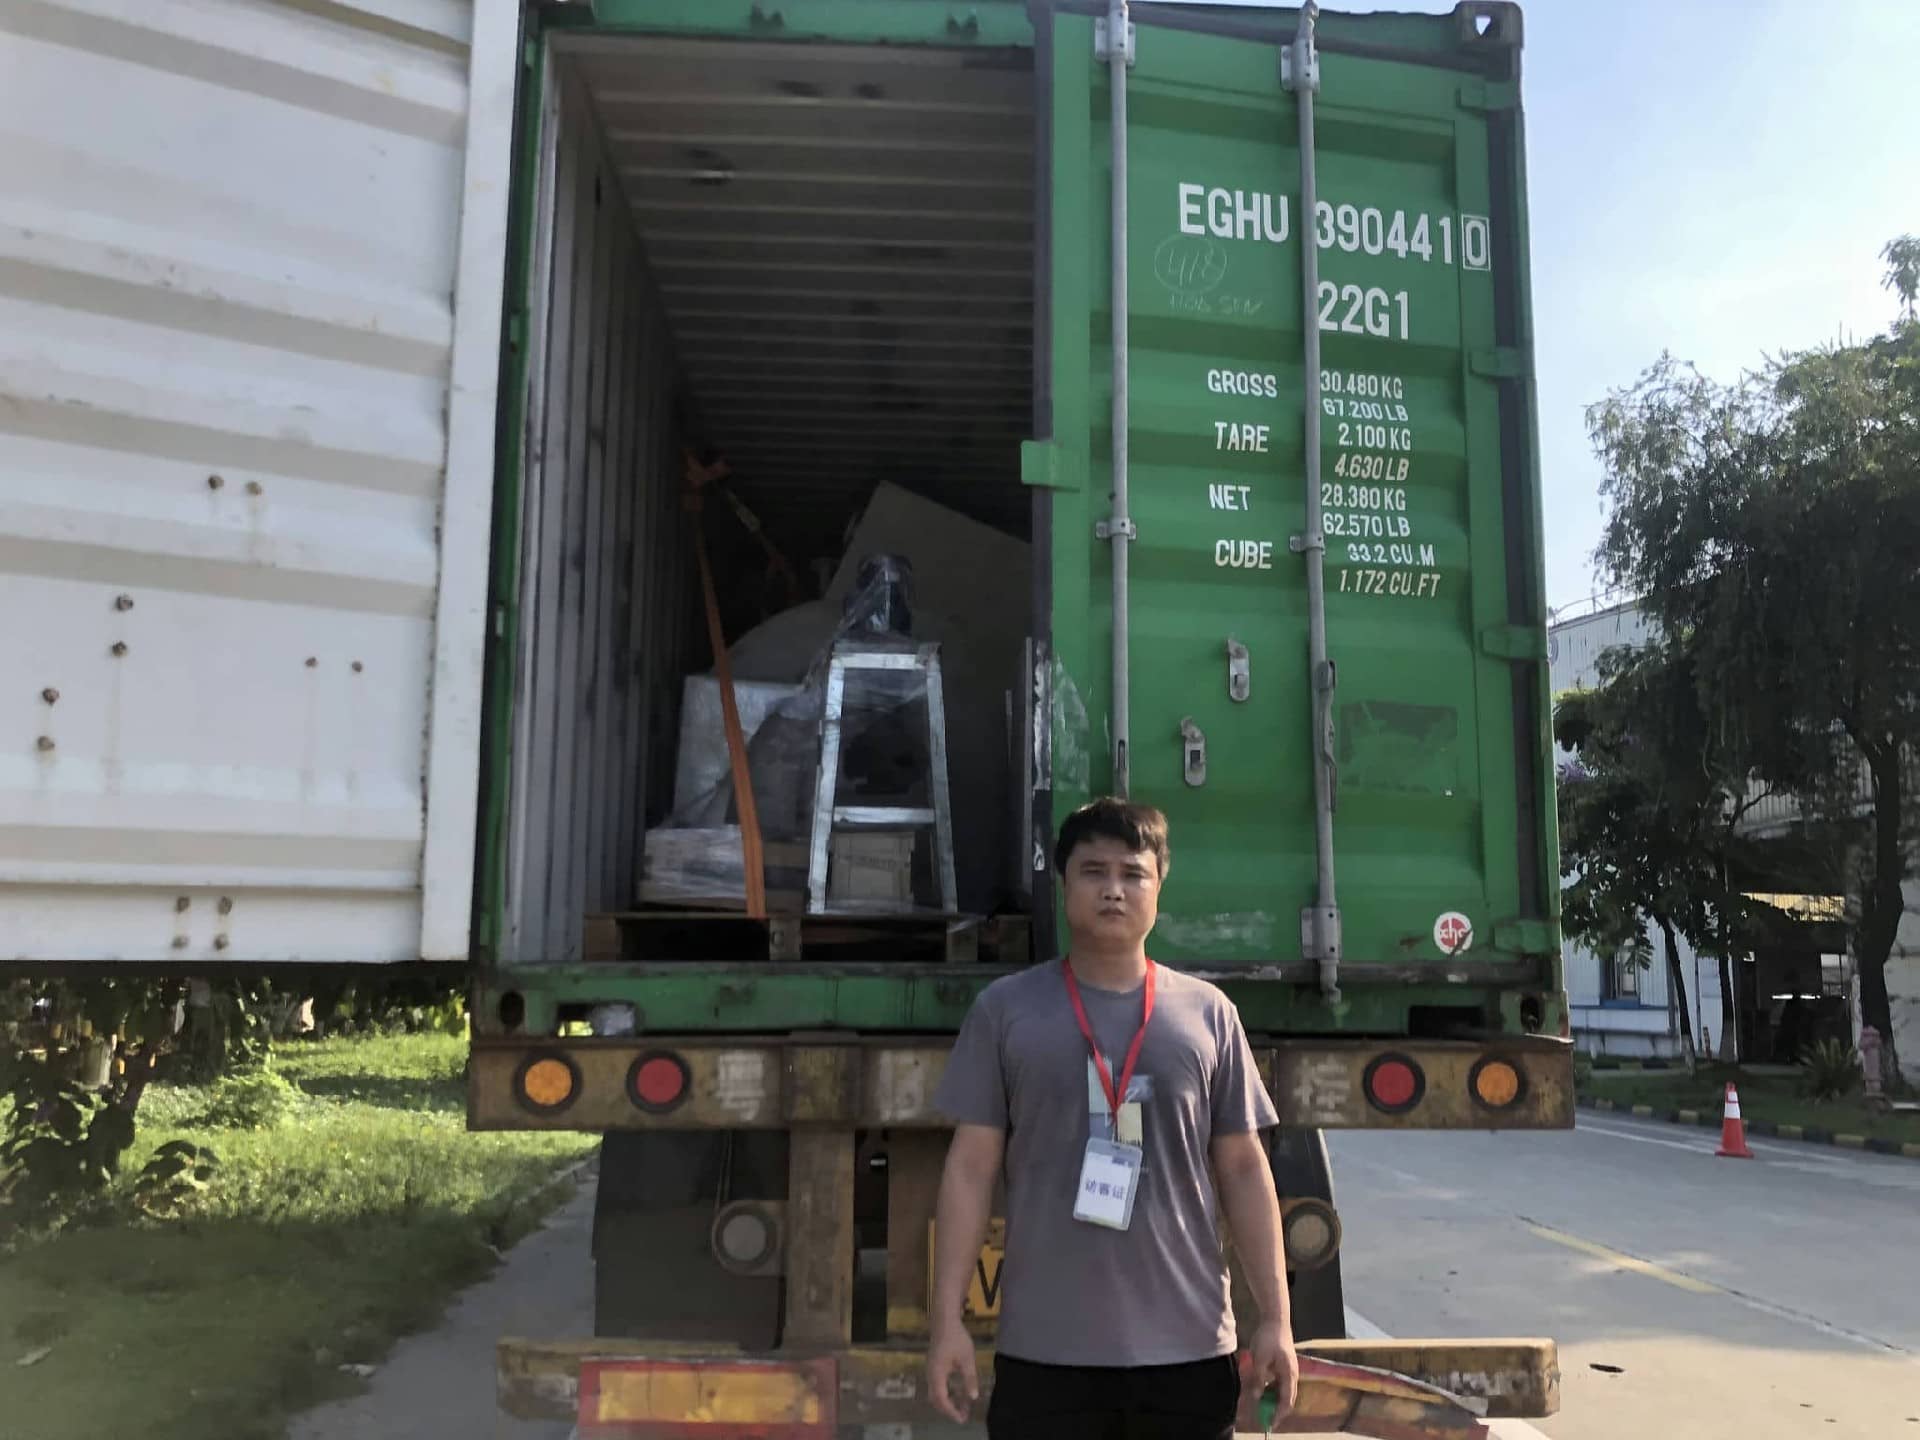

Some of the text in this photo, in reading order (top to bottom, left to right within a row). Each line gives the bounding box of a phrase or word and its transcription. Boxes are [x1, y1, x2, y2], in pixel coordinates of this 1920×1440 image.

[1179, 182, 1488, 267] EGHU 390441 0
[1317, 280, 1409, 340] 22G1
[1207, 369, 1403, 400] GROSS 30.480 KG
[1322, 397, 1409, 421] 67.200 LB
[1214, 421, 1411, 452] TARE 2.100 KG
[1334, 453, 1409, 482] 4.630 LB
[1209, 482, 1406, 511] NET 28.380 KG
[1322, 511, 1411, 537] 62.570 LB
[1215, 539, 1273, 570] CUBE
[1347, 543, 1388, 563] 33.2
[1340, 569, 1387, 594] 1.172
